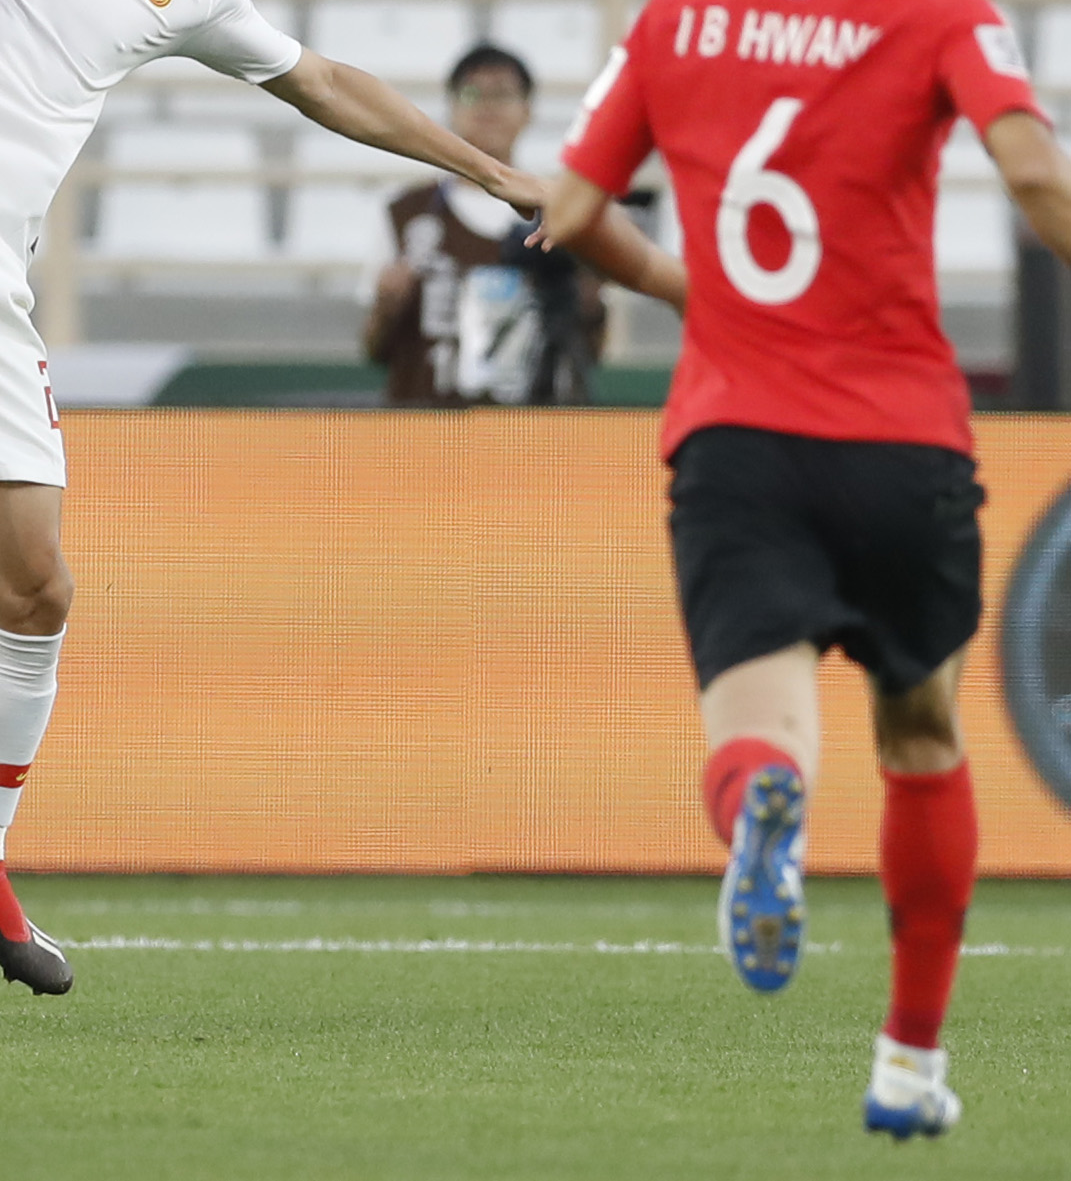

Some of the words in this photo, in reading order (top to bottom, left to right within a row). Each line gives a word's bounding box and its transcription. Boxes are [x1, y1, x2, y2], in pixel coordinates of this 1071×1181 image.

[674, 5, 695, 58] I
[697, 4, 730, 58] B
[737, 7, 884, 69] HWAN
[717, 96, 823, 306] 6
